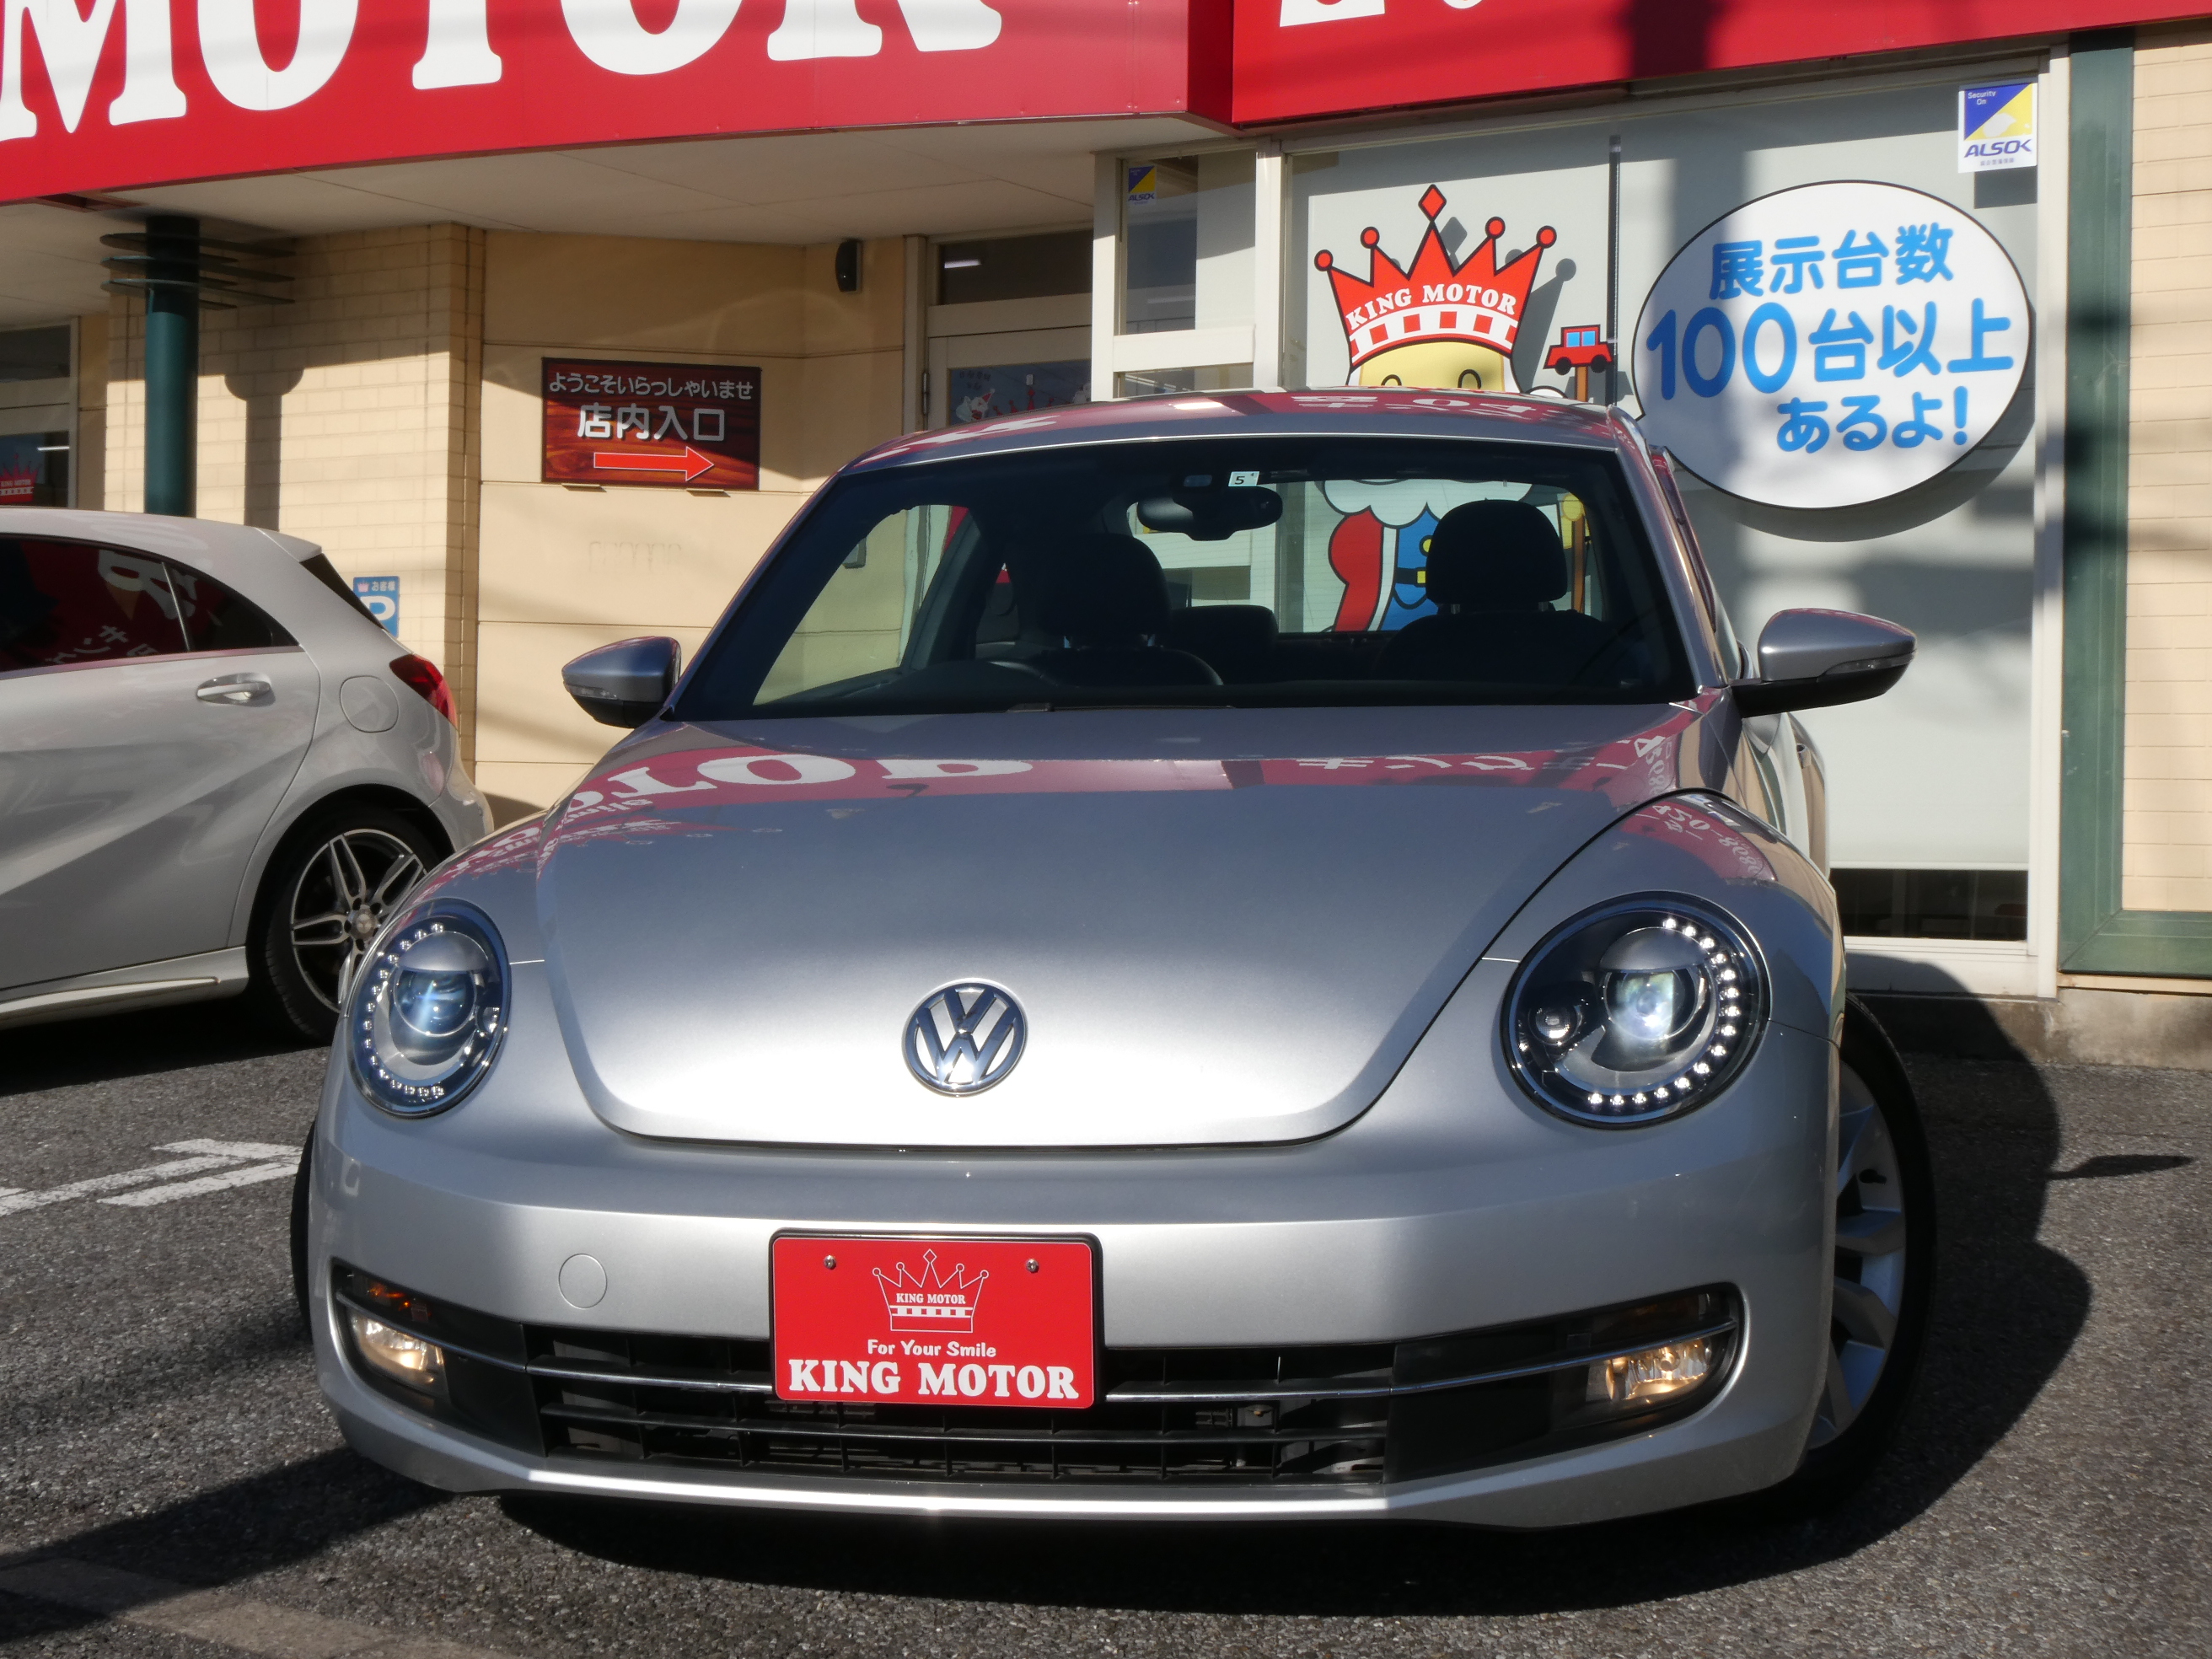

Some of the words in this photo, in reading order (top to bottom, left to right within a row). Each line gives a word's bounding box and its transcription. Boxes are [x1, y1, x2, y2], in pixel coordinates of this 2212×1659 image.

[1968, 90, 1996, 99] Security
[1963, 138, 2032, 158] ALSOK
[1708, 222, 1954, 301] 展示台数
[1345, 287, 1413, 330] KING
[1421, 282, 1517, 315] MOTOR
[1646, 297, 2015, 401] 100台以上
[549, 372, 754, 400] ようこそいらっしゃいませ
[577, 402, 726, 442] 店内入口
[1234, 475, 1245, 485] 5
[896, 1292, 924, 1304] KING
[926, 1293, 966, 1305] MOTOR
[867, 1339, 895, 1356] For
[900, 1340, 941, 1357] Your
[946, 1341, 996, 1358] Smile
[788, 1359, 901, 1394] KING
[917, 1362, 1080, 1399] MOTOR
